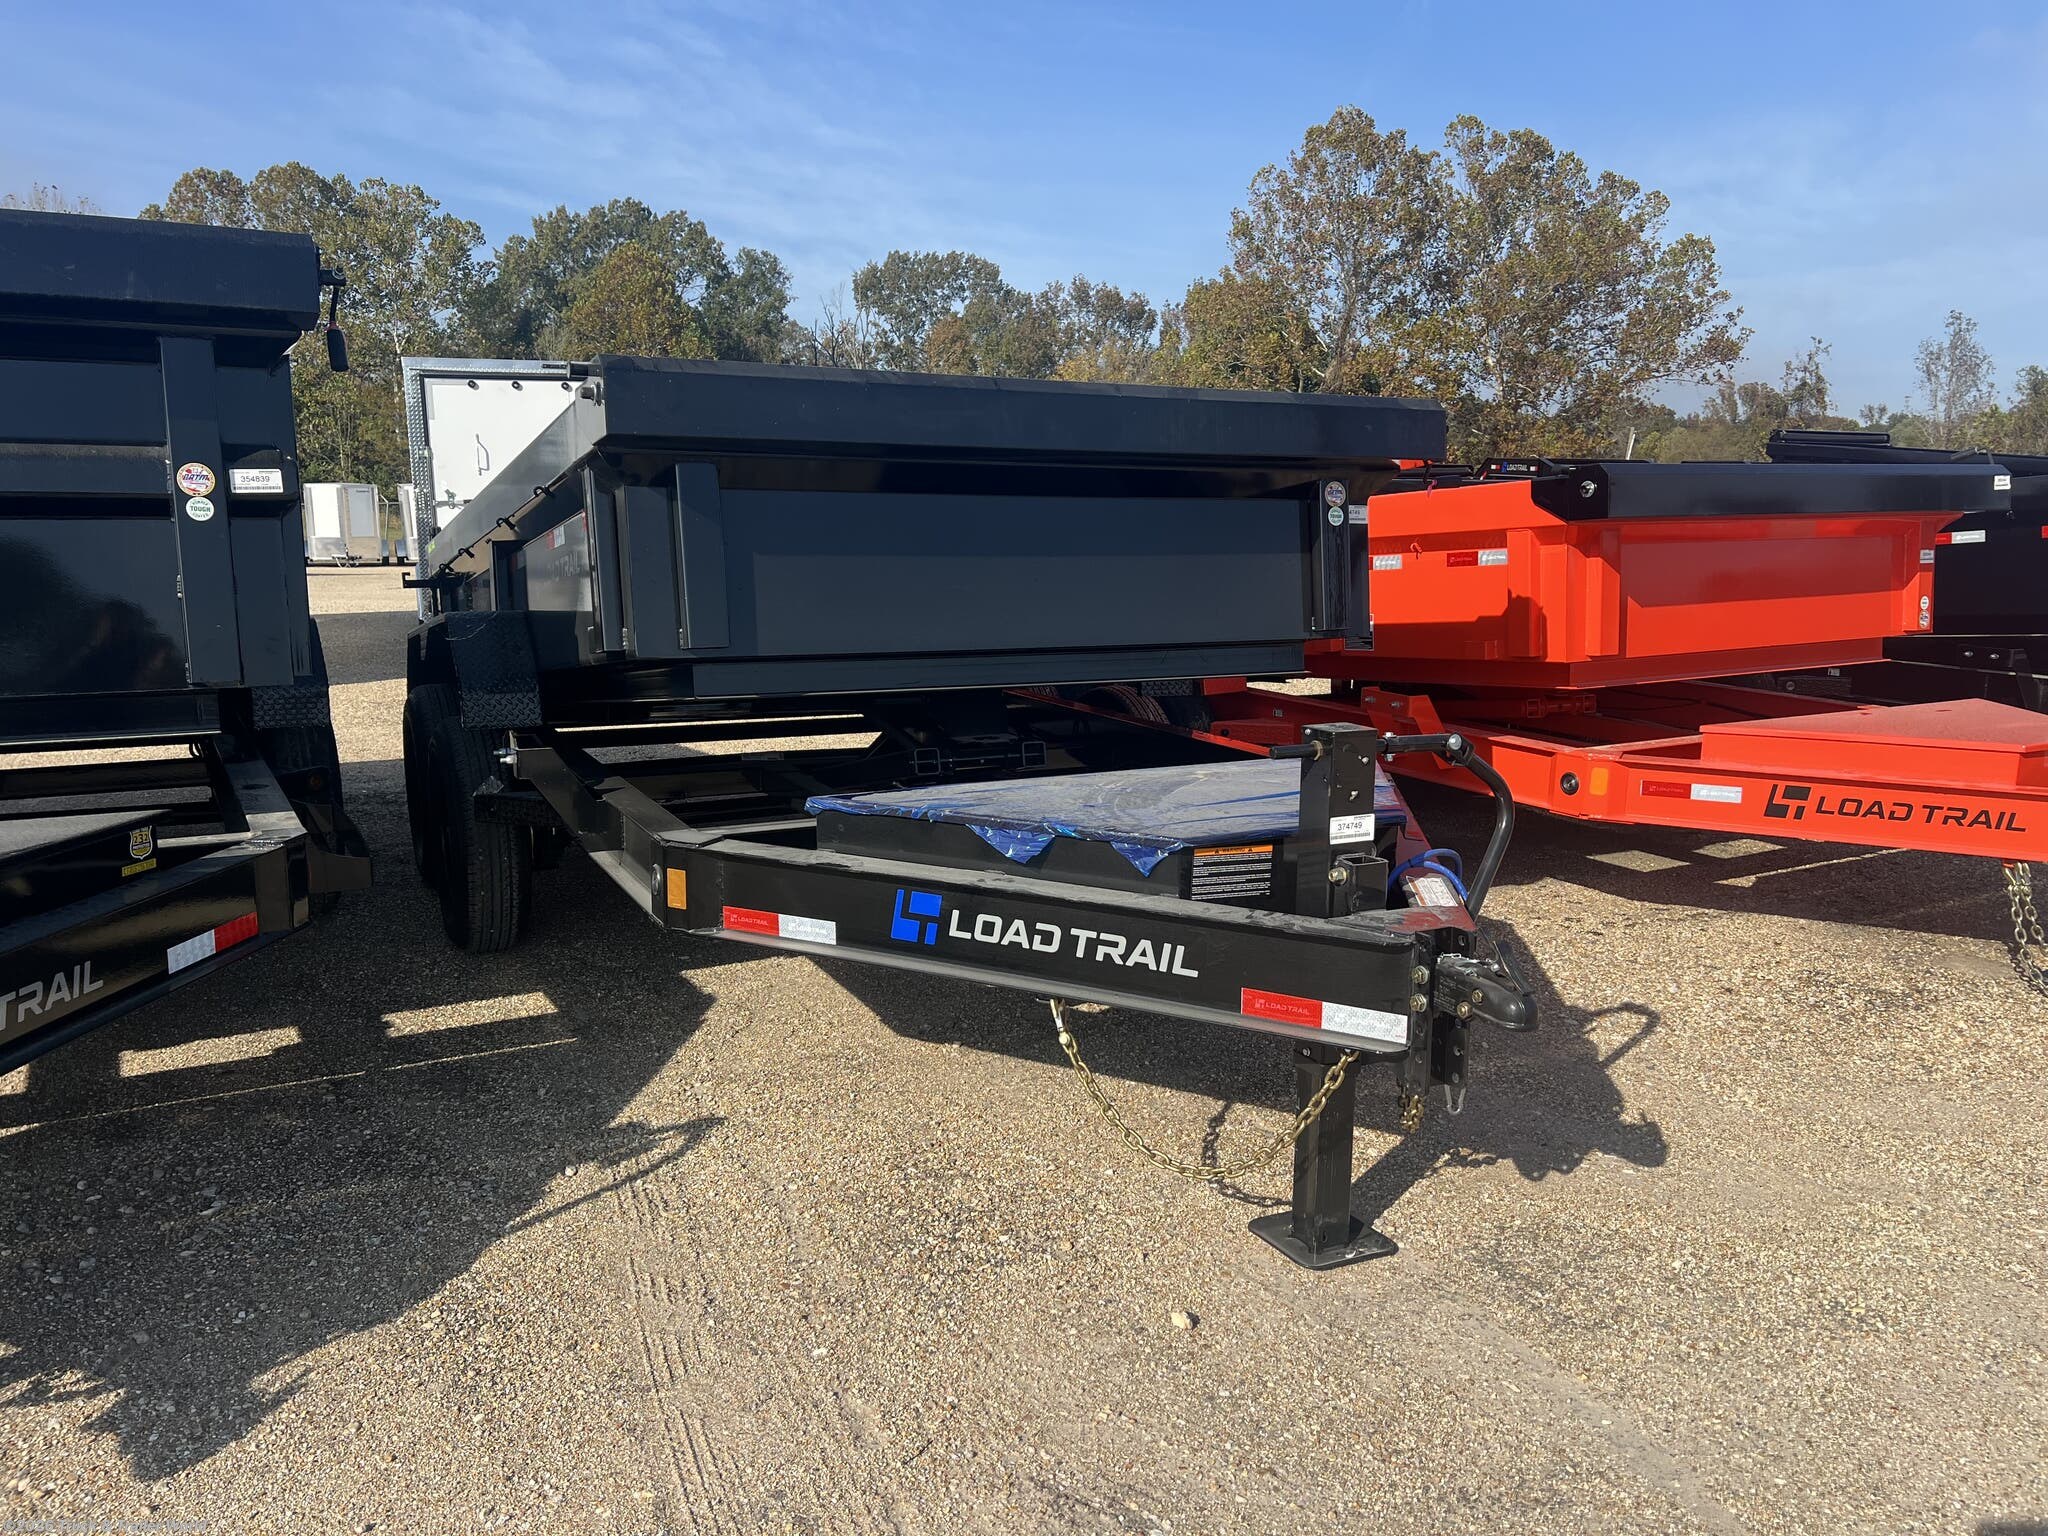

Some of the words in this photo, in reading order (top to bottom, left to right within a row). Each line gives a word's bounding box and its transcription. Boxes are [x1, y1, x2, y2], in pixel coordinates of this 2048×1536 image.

[190, 505, 211, 513] TOUGH
[1337, 821, 1363, 831] 374749
[1815, 795, 1914, 822] LOAD
[1922, 804, 2027, 833] TRAIL
[948, 909, 1062, 953] LOAD
[1070, 928, 1199, 978] TRAIL
[0, 960, 104, 1031] TRAIL
[1265, 1002, 1288, 1011] LOAD
[1288, 1005, 1310, 1016] TRAIL
